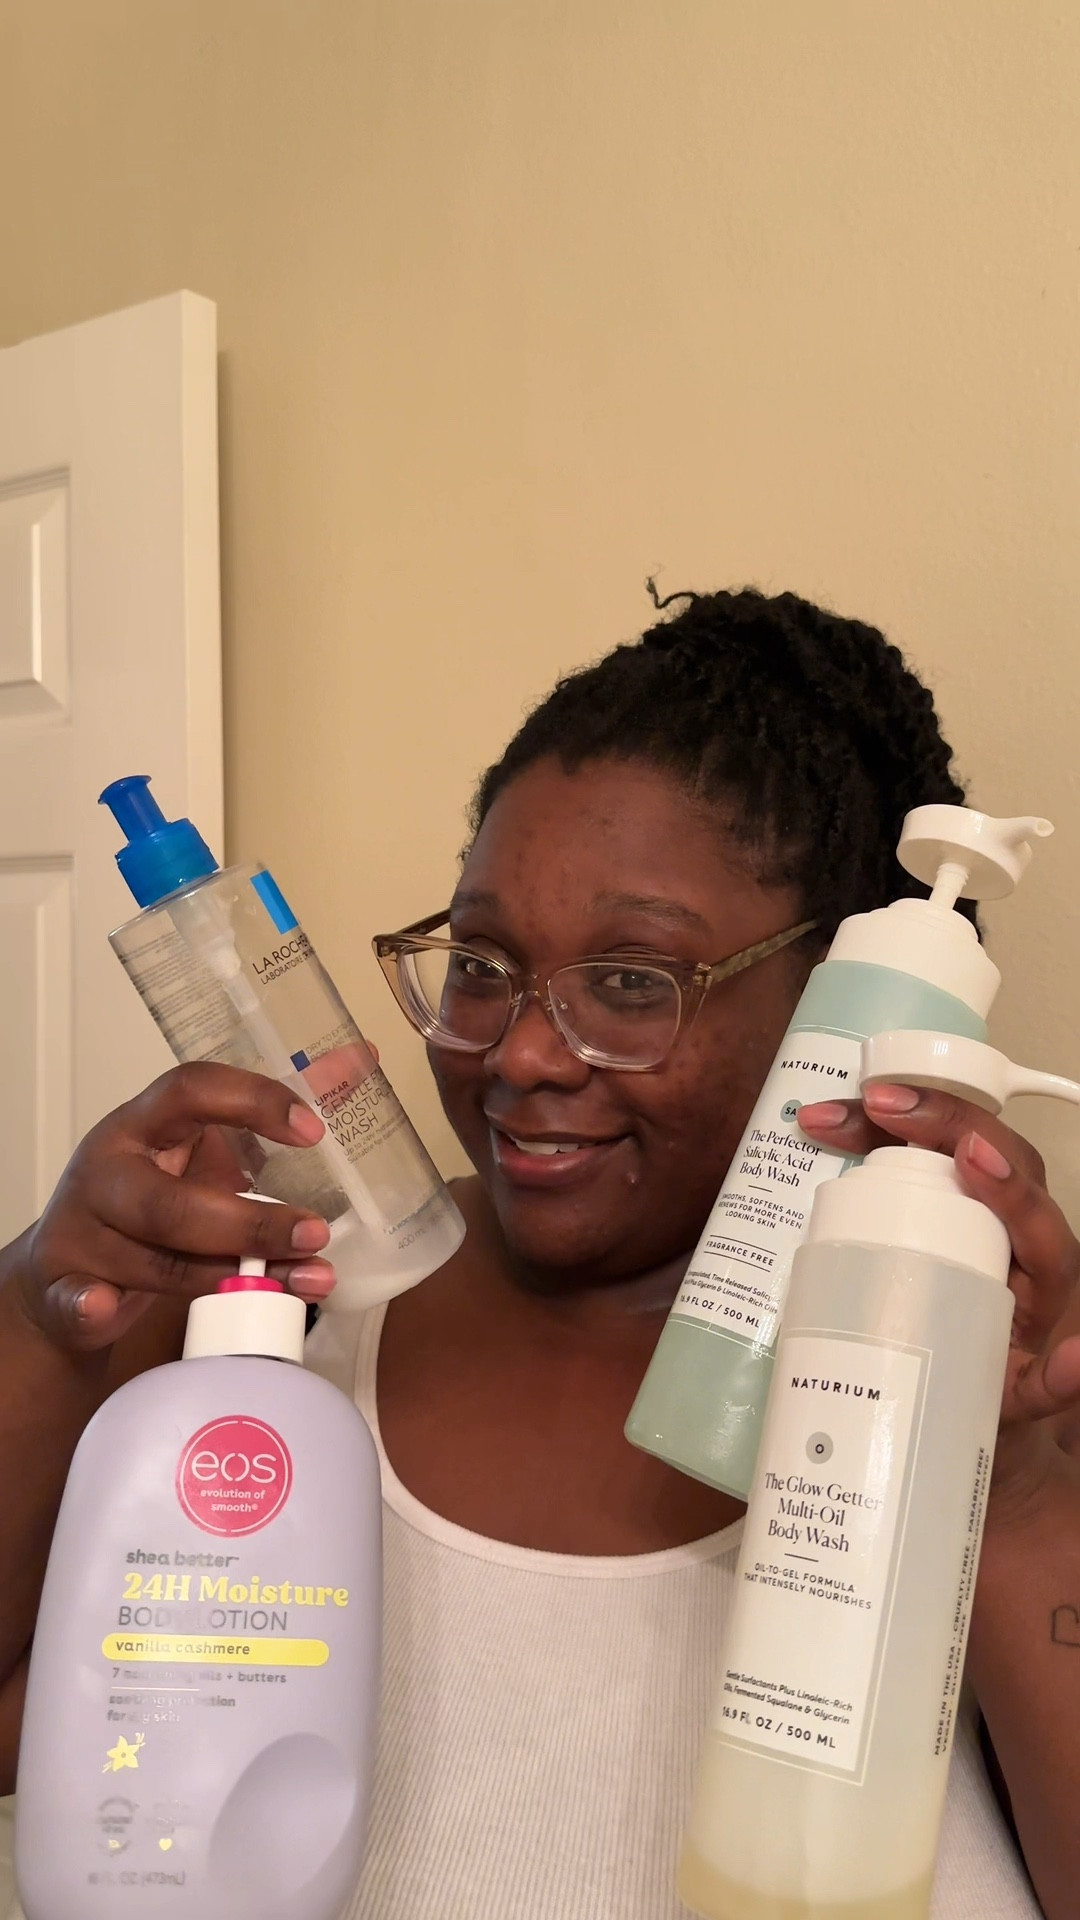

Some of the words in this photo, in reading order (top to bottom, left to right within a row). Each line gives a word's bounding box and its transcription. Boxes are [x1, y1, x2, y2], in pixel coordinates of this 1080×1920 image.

[252, 957, 275, 974] LA
[780, 1060, 848, 1080] NATURIUM
[314, 1080, 350, 1107] LIPIKAR
[320, 1077, 373, 1119] GENTLE
[784, 1106, 797, 1116] SA
[334, 1113, 379, 1147] WASH
[750, 1130, 767, 1142] The
[766, 1130, 823, 1156] Perfector
[744, 1145, 782, 1163] Salicylic
[782, 1152, 814, 1172] Acid
[740, 1162, 764, 1179] Body
[767, 1166, 800, 1187] Wash
[725, 1210, 755, 1223] LOOKING
[756, 1218, 776, 1230] SKIN
[738, 1203, 753, 1212] FOR
[754, 1208, 778, 1220] MORE
[778, 1215, 802, 1230] EVEN
[748, 1196, 784, 1213] SOFTENS
[786, 1208, 804, 1220] AND
[706, 1240, 748, 1257] FRAGRANCE
[750, 1252, 774, 1266] FREE
[696, 1280, 717, 1290] Glycerin
[722, 1288, 764, 1308] Linoleic-Rich
[711, 1274, 724, 1283] Time
[724, 1278, 753, 1292] Released
[690, 1296, 699, 1306] FL
[701, 1299, 714, 1310] OZ
[715, 1304, 722, 1312] /
[723, 1307, 742, 1320] 500
[746, 1316, 760, 1328] ML
[791, 1377, 881, 1401] NATURIUM
[191, 1450, 277, 1484] eos
[976, 1447, 986, 1475] FREE
[200, 1488, 252, 1499] evolution
[254, 1490, 266, 1500] of
[765, 1472, 785, 1491] The
[786, 1475, 824, 1496] Glow
[826, 1483, 882, 1510] Getter
[777, 1498, 846, 1527] Multi-Oil
[968, 1478, 981, 1533] PARABEN
[768, 1519, 802, 1544] Body
[806, 1526, 850, 1552] Wash
[126, 1549, 170, 1565] shea
[962, 1545, 970, 1575] FREE
[122, 1572, 192, 1602] 24H
[198, 1575, 350, 1607] Moisture
[744, 1572, 758, 1582] THAT
[760, 1575, 806, 1593] INTENSELY
[808, 1586, 872, 1610] NOURISHES
[754, 1562, 800, 1580] OIL-TO-GEL
[802, 1572, 855, 1593] FORMULA
[118, 1606, 190, 1629] BOD
[953, 1578, 966, 1632] CRUELTY
[116, 1639, 172, 1654] vanilla
[176, 1640, 250, 1656] cashmere
[947, 1646, 956, 1670] USA
[112, 1668, 120, 1678] 7
[238, 1671, 287, 1683] butters
[942, 1674, 951, 1697] THE
[726, 1670, 740, 1680] Gentle
[740, 1674, 778, 1692] Surfactants
[778, 1684, 796, 1696] Plus
[796, 1689, 853, 1712] Linoleic-Rich
[734, 1685, 766, 1702] Fermented
[766, 1694, 804, 1712] Squalane
[804, 1705, 812, 1714] &
[813, 1708, 850, 1724] Glycerin
[940, 1701, 948, 1714] IN
[722, 1706, 738, 1720] 16.9
[740, 1711, 752, 1724] FL
[755, 1716, 773, 1730] OZ
[774, 1722, 784, 1734] /
[786, 1725, 812, 1741] 500
[816, 1734, 836, 1748] ML
[934, 1720, 945, 1756] MADE
[942, 1709, 952, 1752] VEGAN
